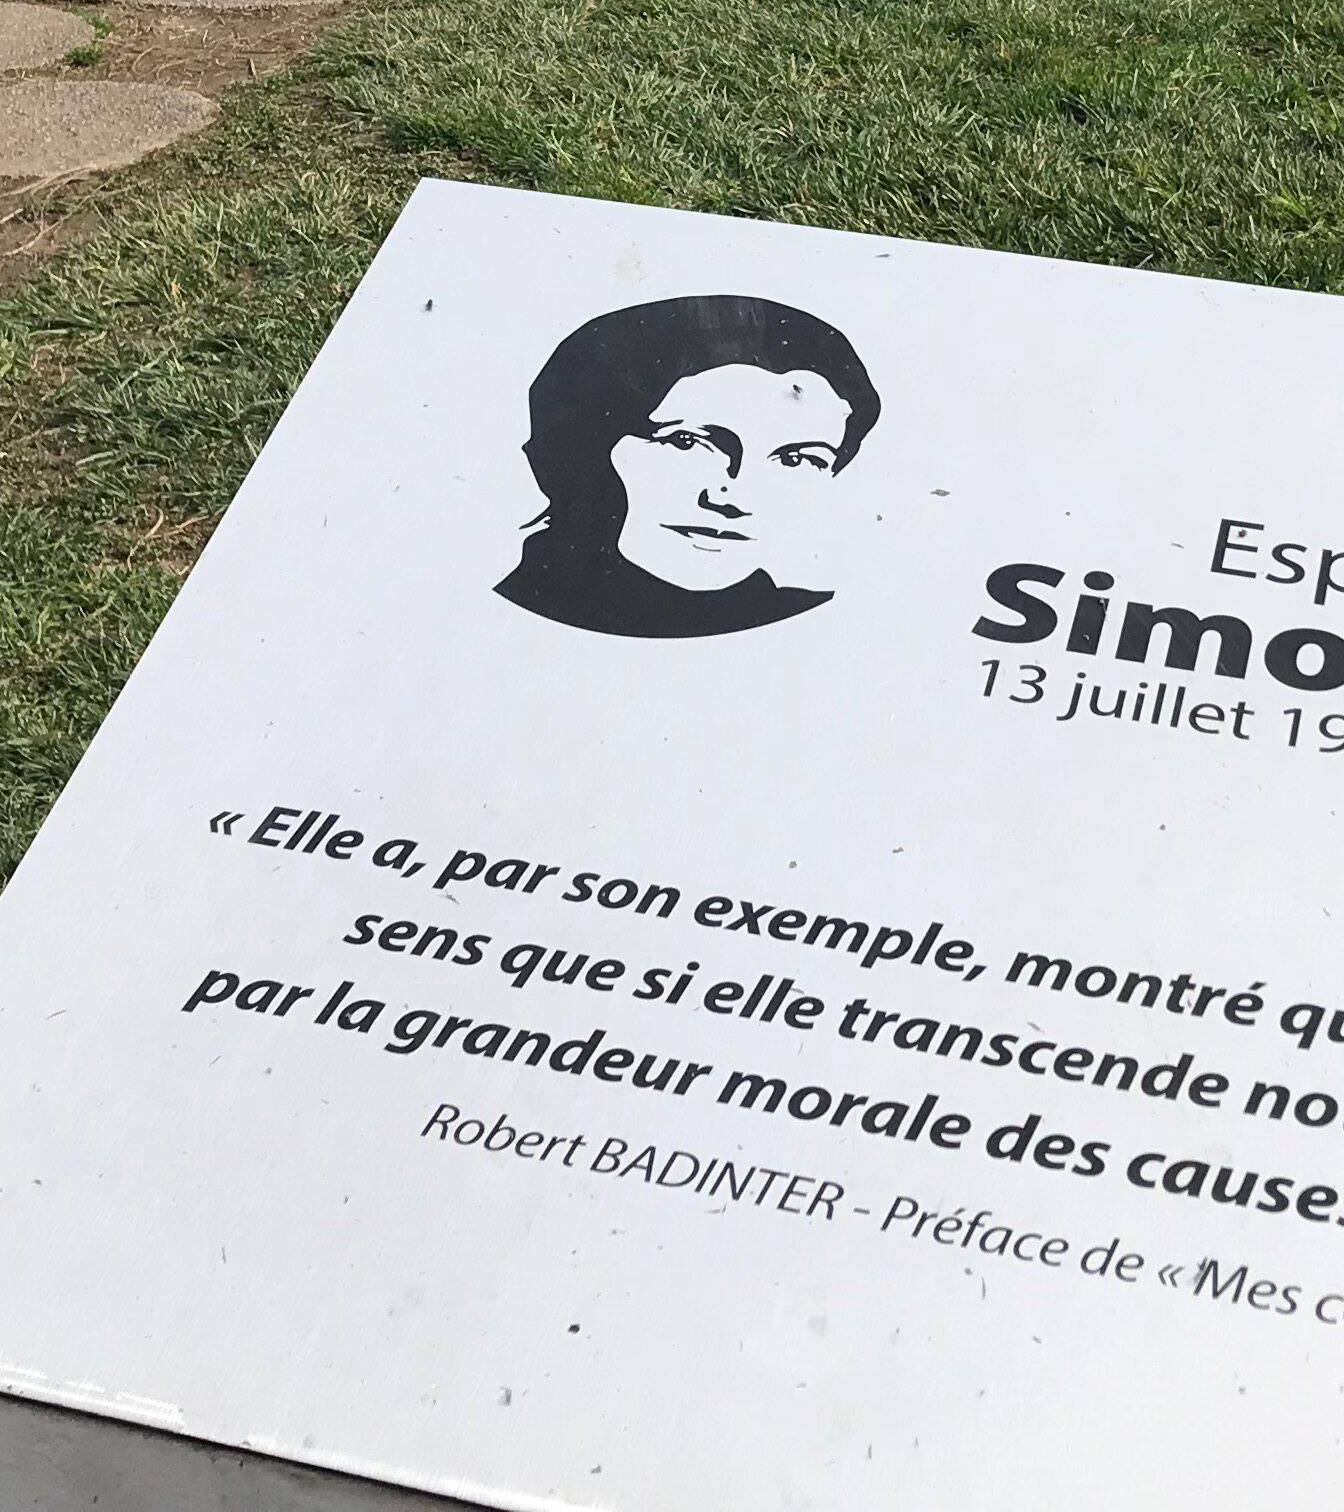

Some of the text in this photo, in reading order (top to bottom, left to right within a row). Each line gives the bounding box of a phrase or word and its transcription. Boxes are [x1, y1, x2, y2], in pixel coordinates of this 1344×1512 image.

[981, 659, 1047, 704] 13
[1056, 671, 1256, 740] juillet
[246, 805, 365, 860] Elle
[372, 838, 428, 879] a,
[431, 848, 561, 894] par
[561, 872, 681, 919] son
[693, 895, 988, 983] exemple,
[1004, 951, 1268, 1027] montré
[342, 915, 493, 966] sens
[499, 943, 626, 992] que
[632, 961, 701, 1006] si
[703, 974, 826, 1031] elle
[837, 998, 1230, 1109] transcende
[180, 969, 315, 1018] par
[313, 980, 387, 1035] la
[383, 1009, 714, 1097] grandeur
[715, 1070, 973, 1150] morale
[985, 1113, 1113, 1178] des
[419, 1103, 588, 1168] Robert
[589, 1136, 845, 1221] BADINTER
[879, 1195, 1070, 1267] Préface
[1079, 1237, 1145, 1283] de
[1193, 1258, 1303, 1316] Mes
